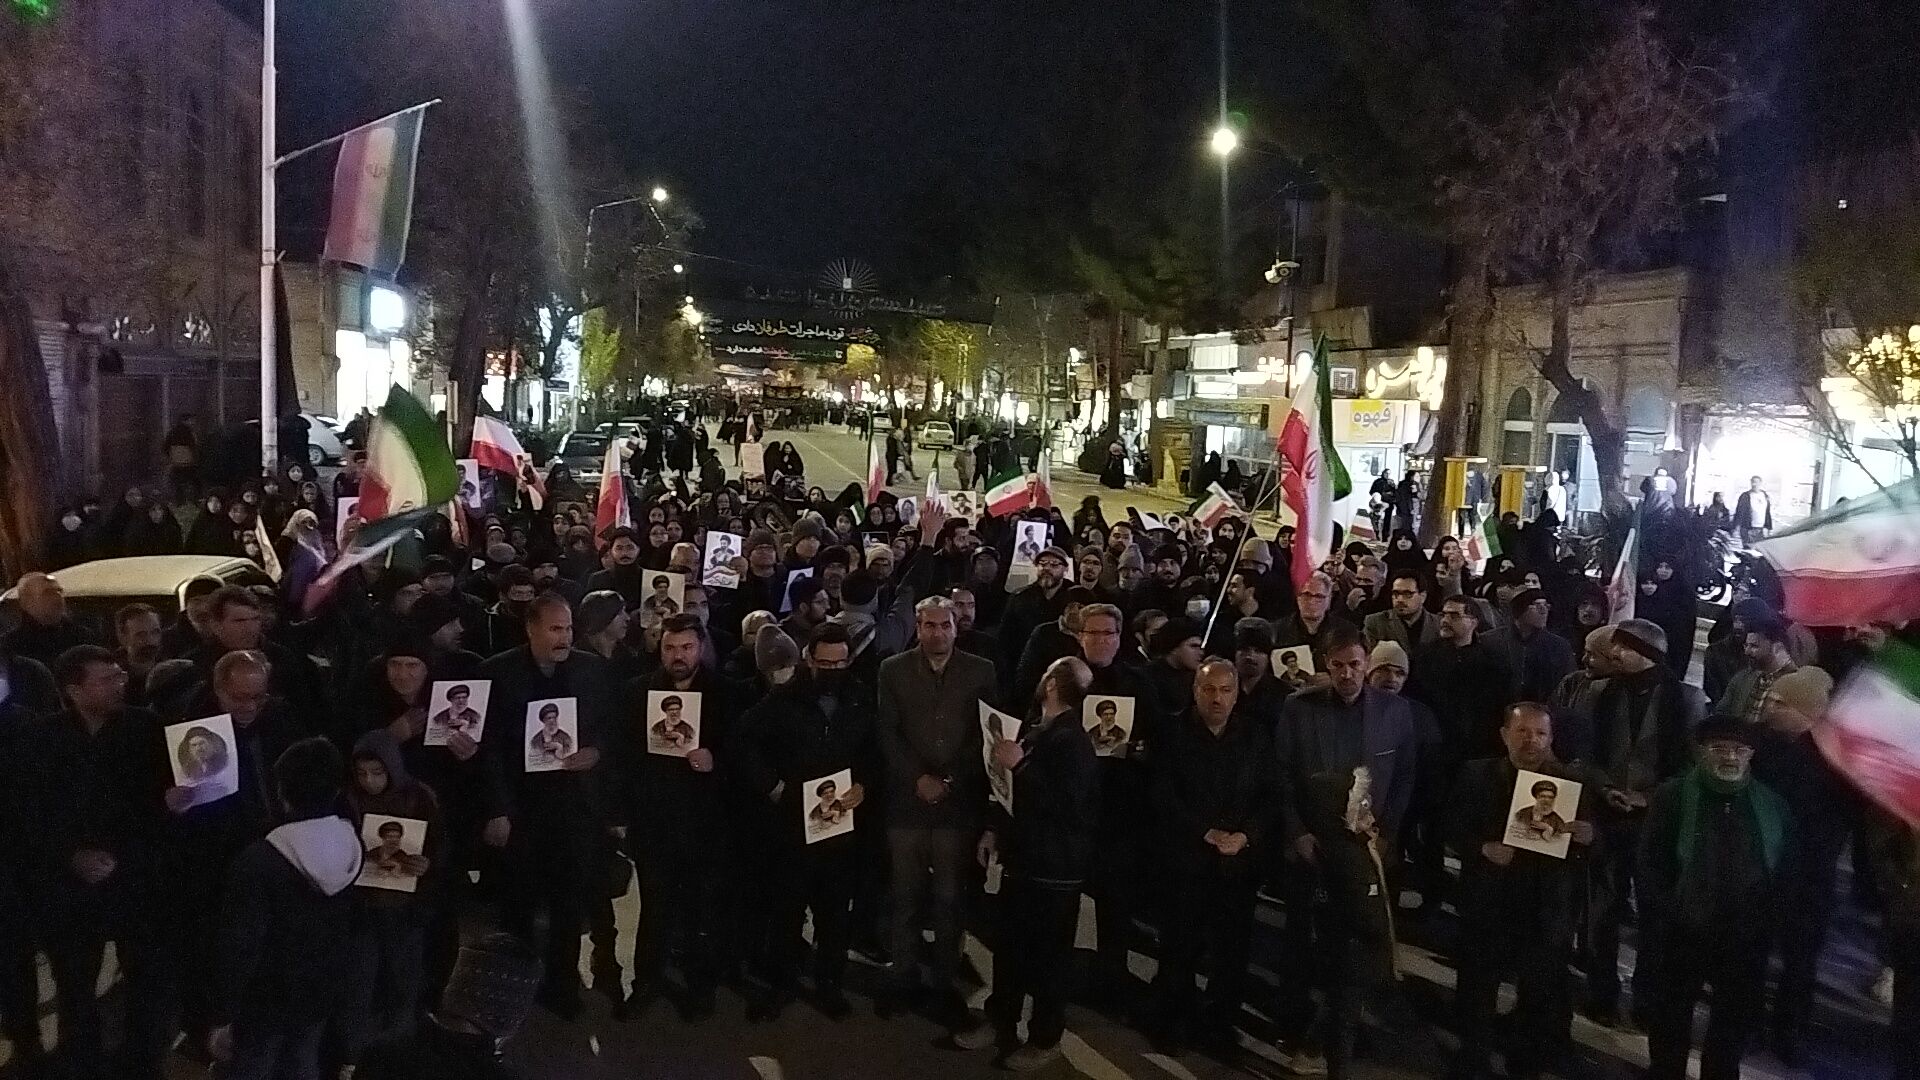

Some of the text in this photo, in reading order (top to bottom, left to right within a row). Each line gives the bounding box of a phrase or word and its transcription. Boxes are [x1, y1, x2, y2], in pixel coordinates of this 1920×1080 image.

[732, 319, 755, 333] دادی
[755, 318, 789, 336] طوفان
[1354, 402, 1392, 428] قهوه
